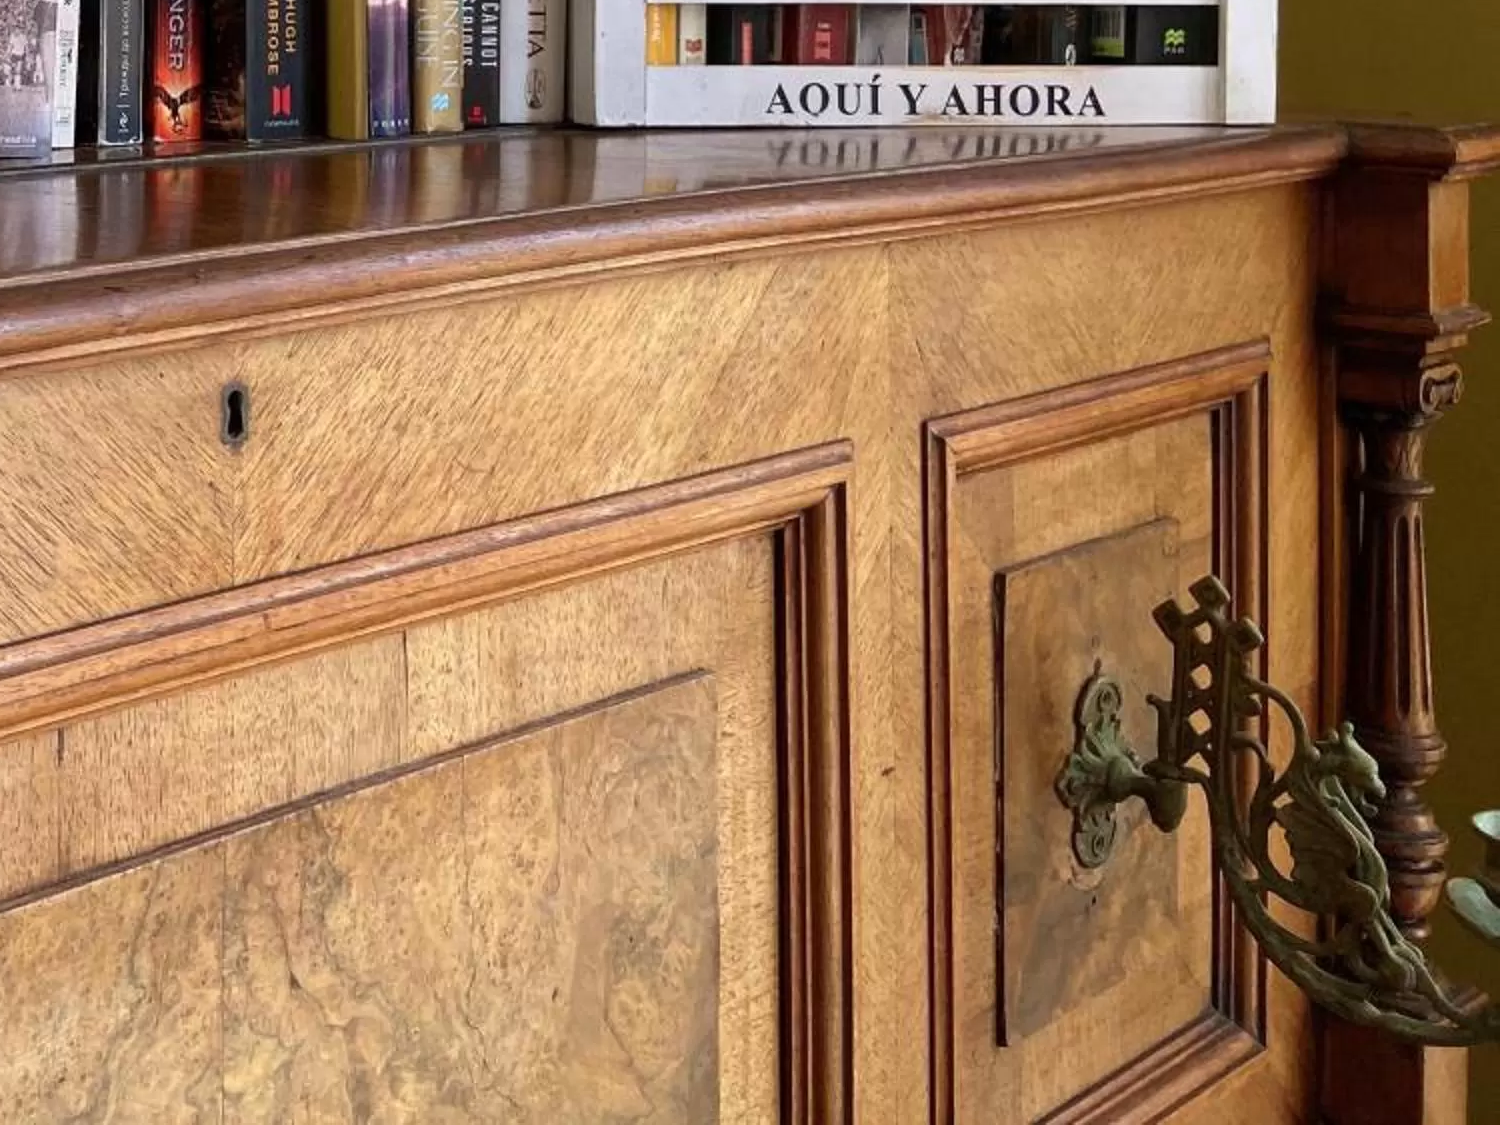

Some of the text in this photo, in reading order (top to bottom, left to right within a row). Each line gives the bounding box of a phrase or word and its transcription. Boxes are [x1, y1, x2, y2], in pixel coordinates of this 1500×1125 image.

[480, 2, 500, 68] CANNOT
[765, 73, 1107, 118] AQUÍ Y AHORA
